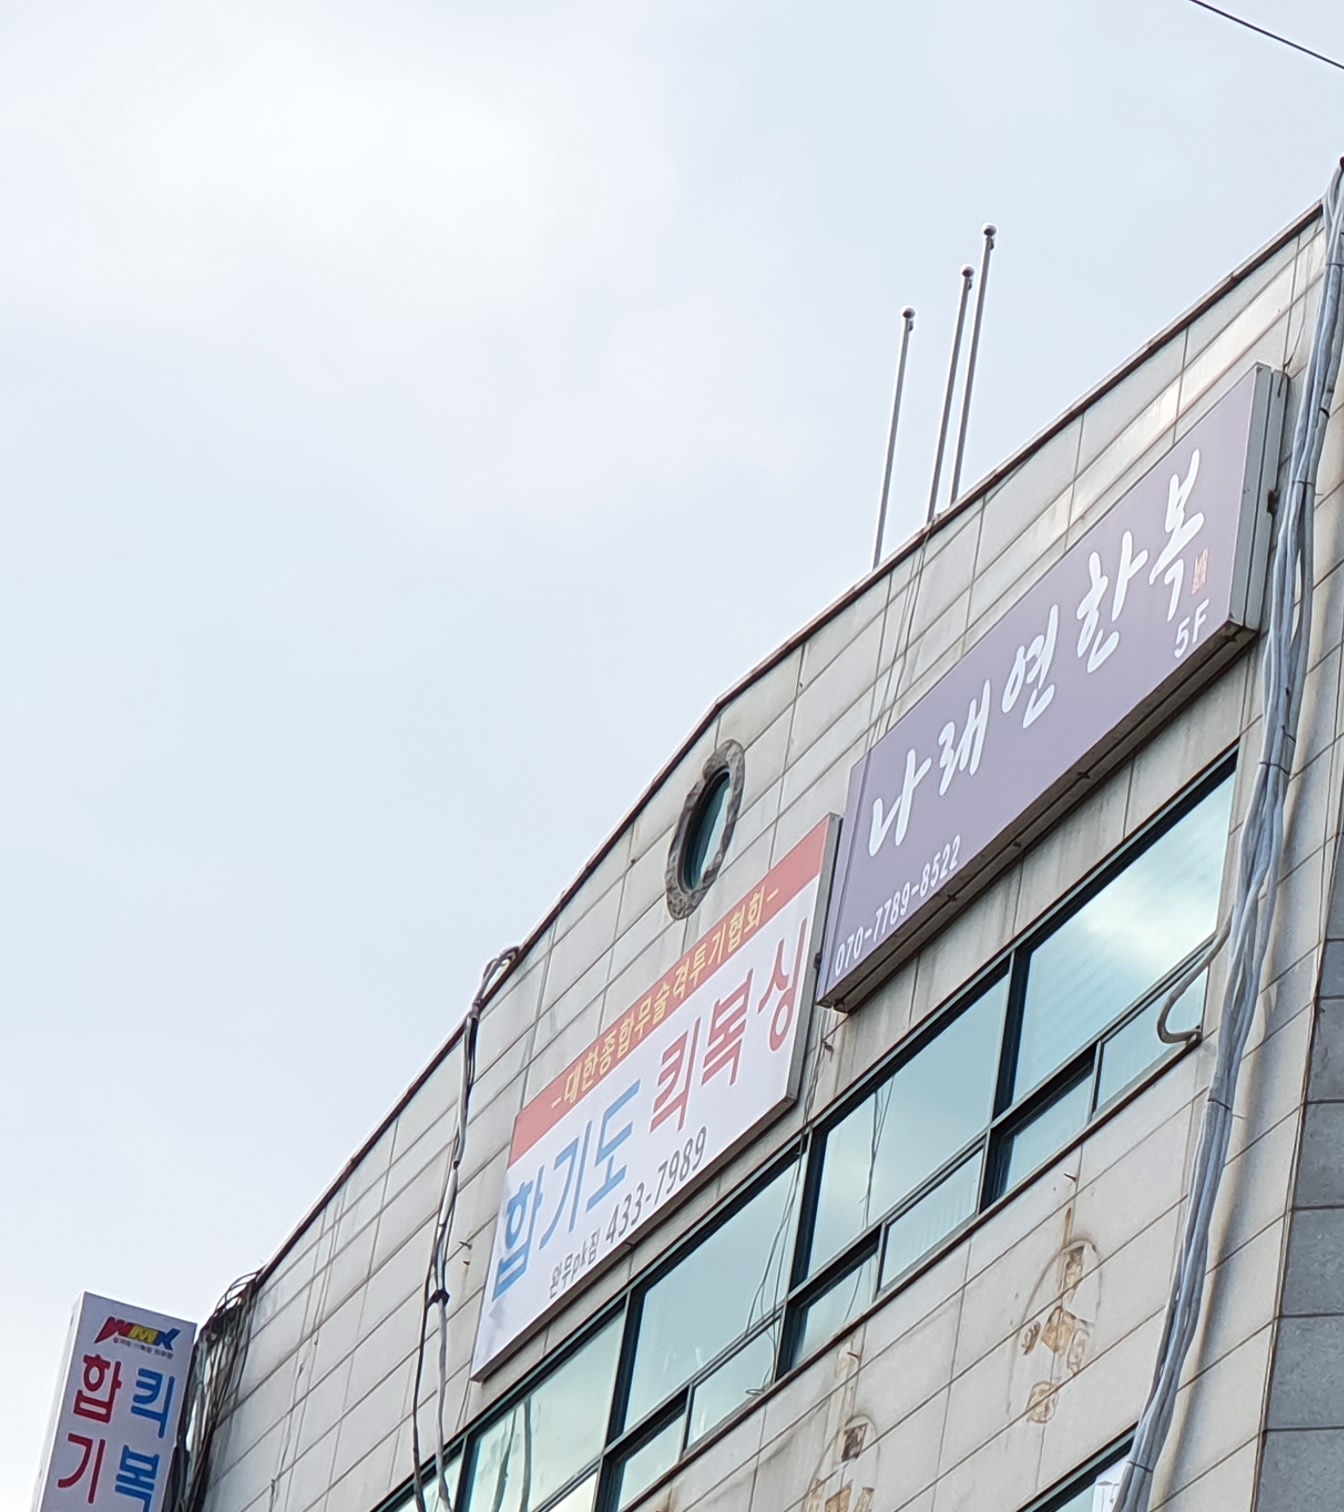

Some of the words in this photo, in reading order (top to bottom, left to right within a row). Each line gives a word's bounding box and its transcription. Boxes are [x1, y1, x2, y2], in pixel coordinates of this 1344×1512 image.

[1175, 599, 1209, 659] 5F
[834, 834, 962, 978] 070-7789-8522
[604, 1125, 707, 1245] 433-7989
